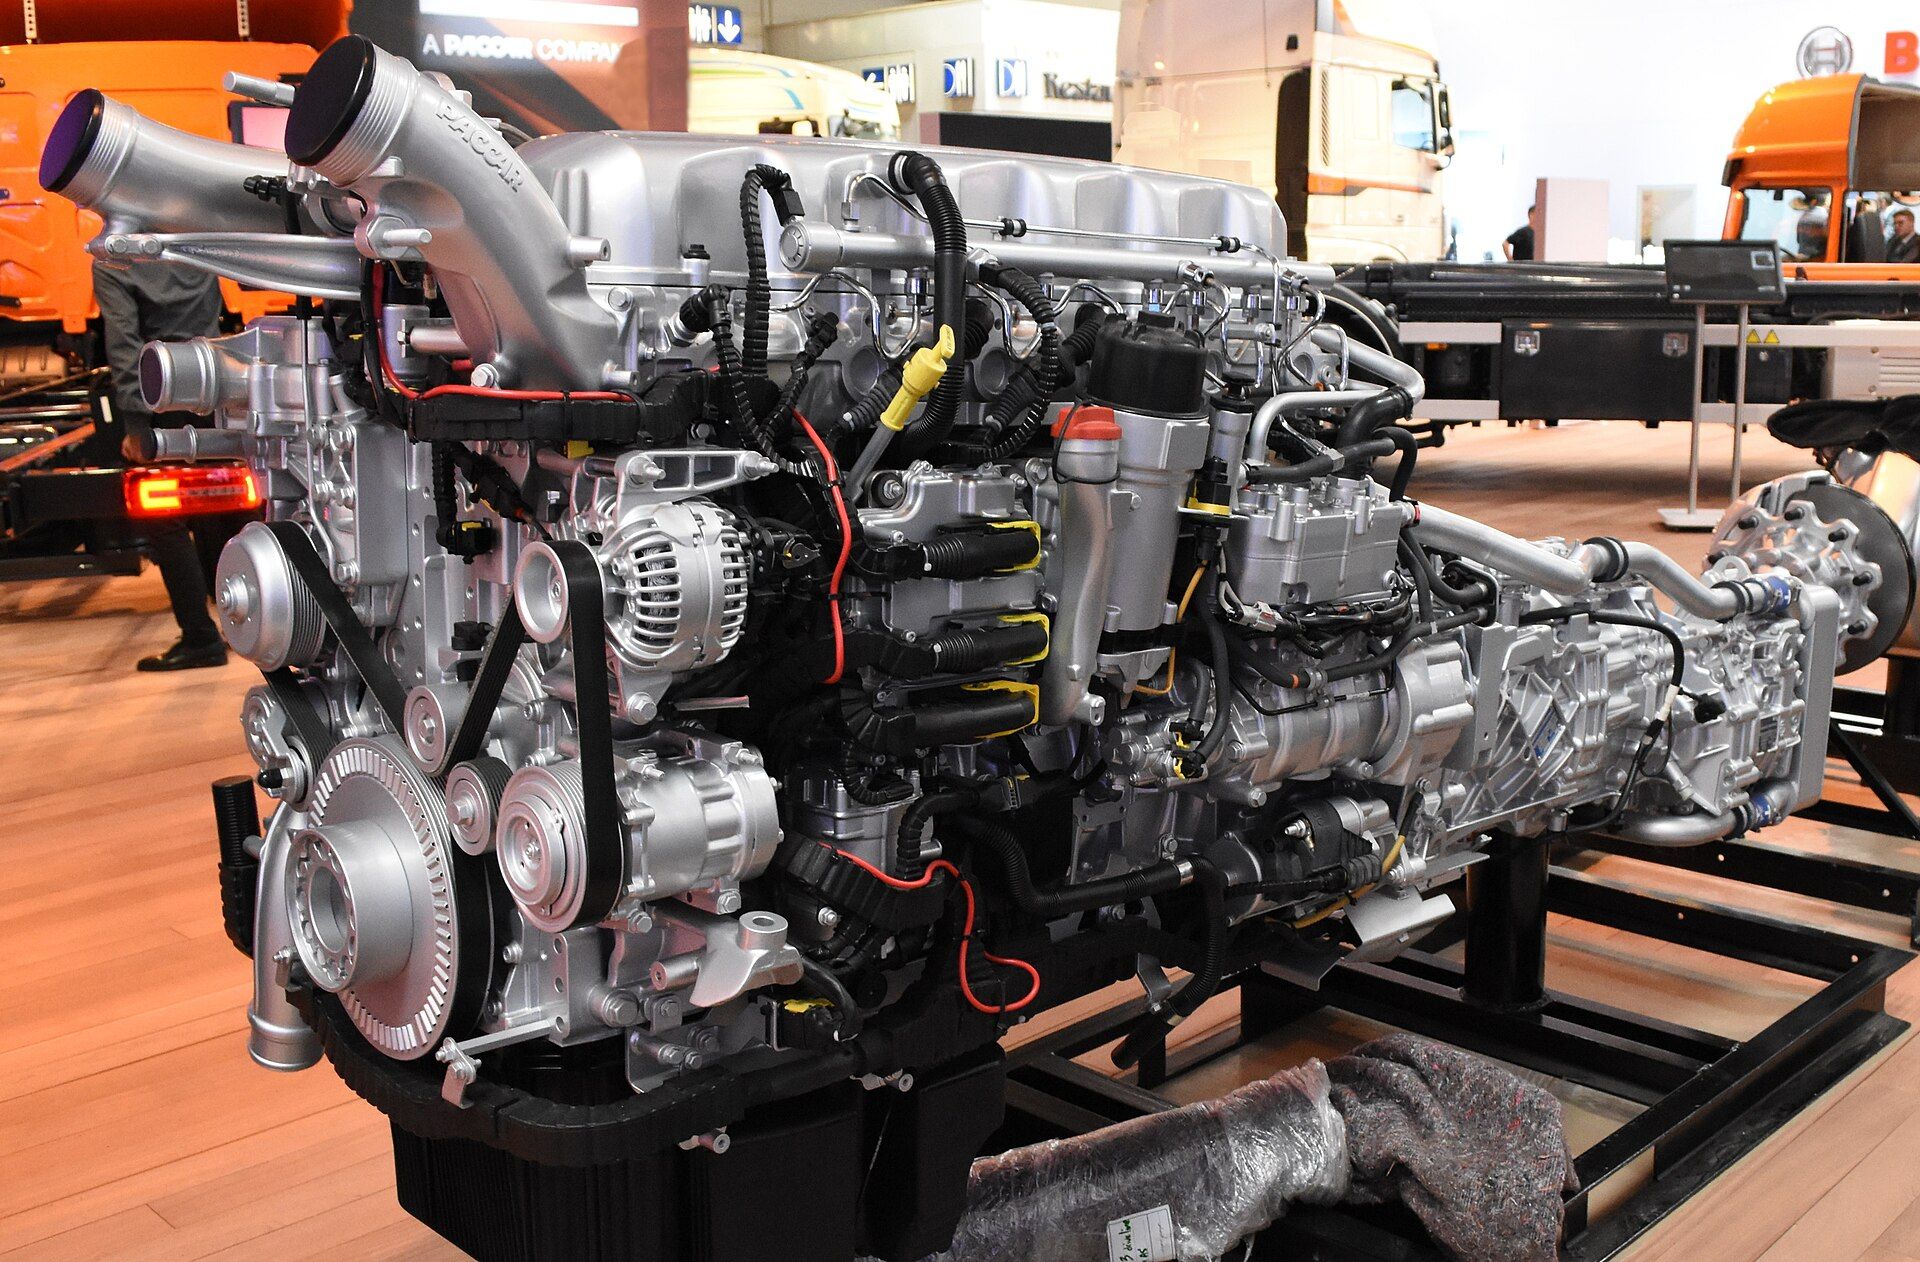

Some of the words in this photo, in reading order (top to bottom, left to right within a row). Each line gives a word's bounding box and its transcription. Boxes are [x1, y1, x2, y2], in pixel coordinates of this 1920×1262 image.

[422, 33, 440, 56] A
[1884, 31, 1920, 74] B
[435, 100, 525, 193] PACCAR
